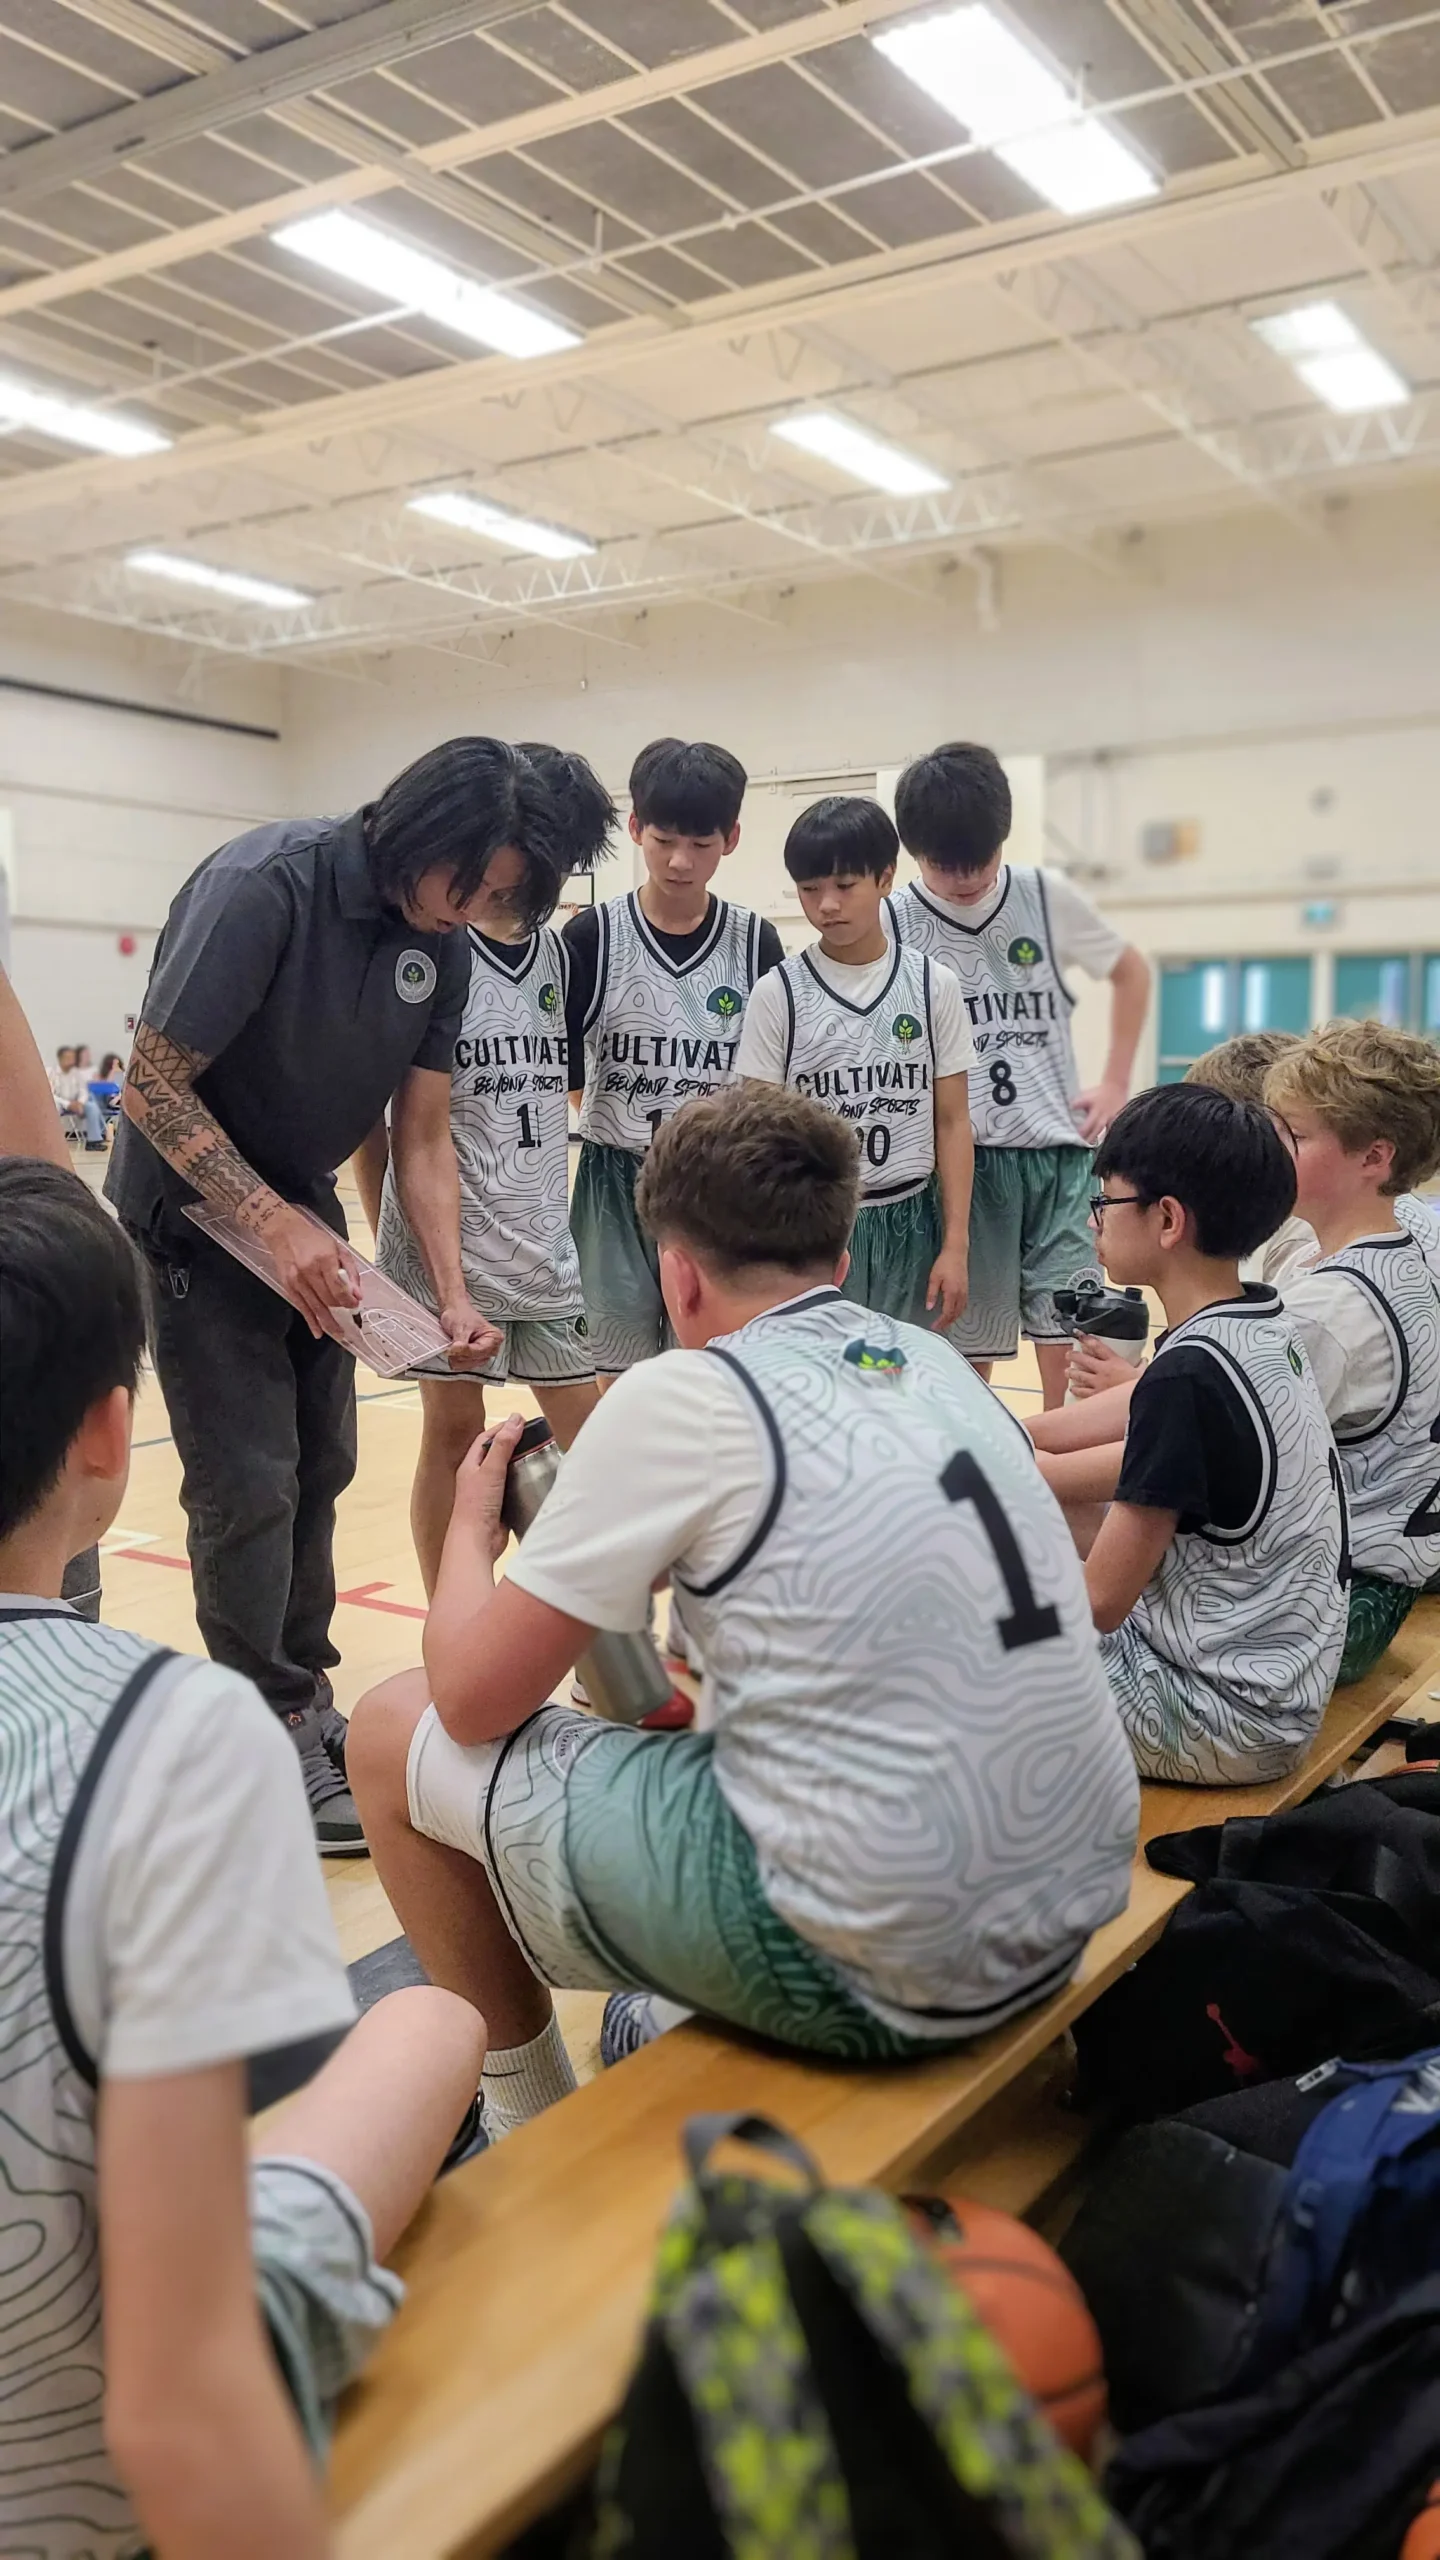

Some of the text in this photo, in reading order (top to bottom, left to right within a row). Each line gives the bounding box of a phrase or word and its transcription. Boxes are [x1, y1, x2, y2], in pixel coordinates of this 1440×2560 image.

[473, 1072, 528, 1106] BEYOND
[604, 1071, 669, 1105] BEYOND
[989, 1060, 1018, 1107] 8
[868, 1096, 921, 1116] SPORTS
[938, 1449, 1063, 1653] 1
